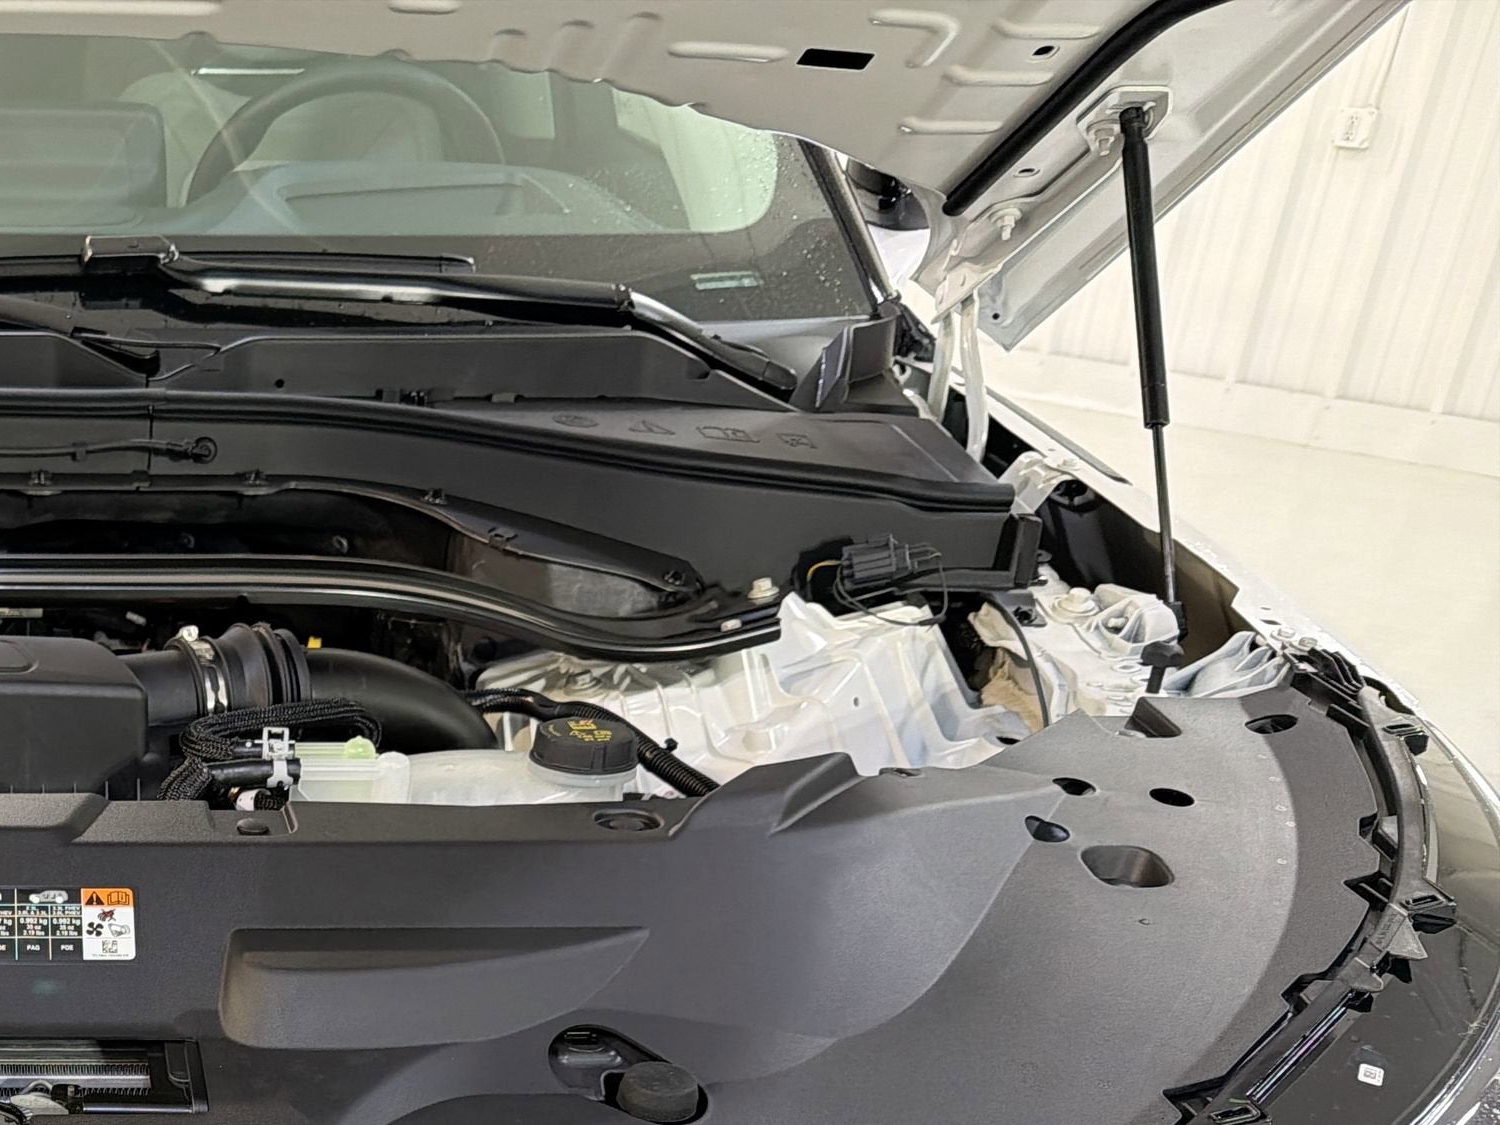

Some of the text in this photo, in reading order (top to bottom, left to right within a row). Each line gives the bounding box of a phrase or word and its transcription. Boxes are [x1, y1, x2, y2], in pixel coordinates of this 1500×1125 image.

[3, 918, 13, 926] kg
[39, 918, 48, 926] kg
[72, 918, 81, 926] kg
